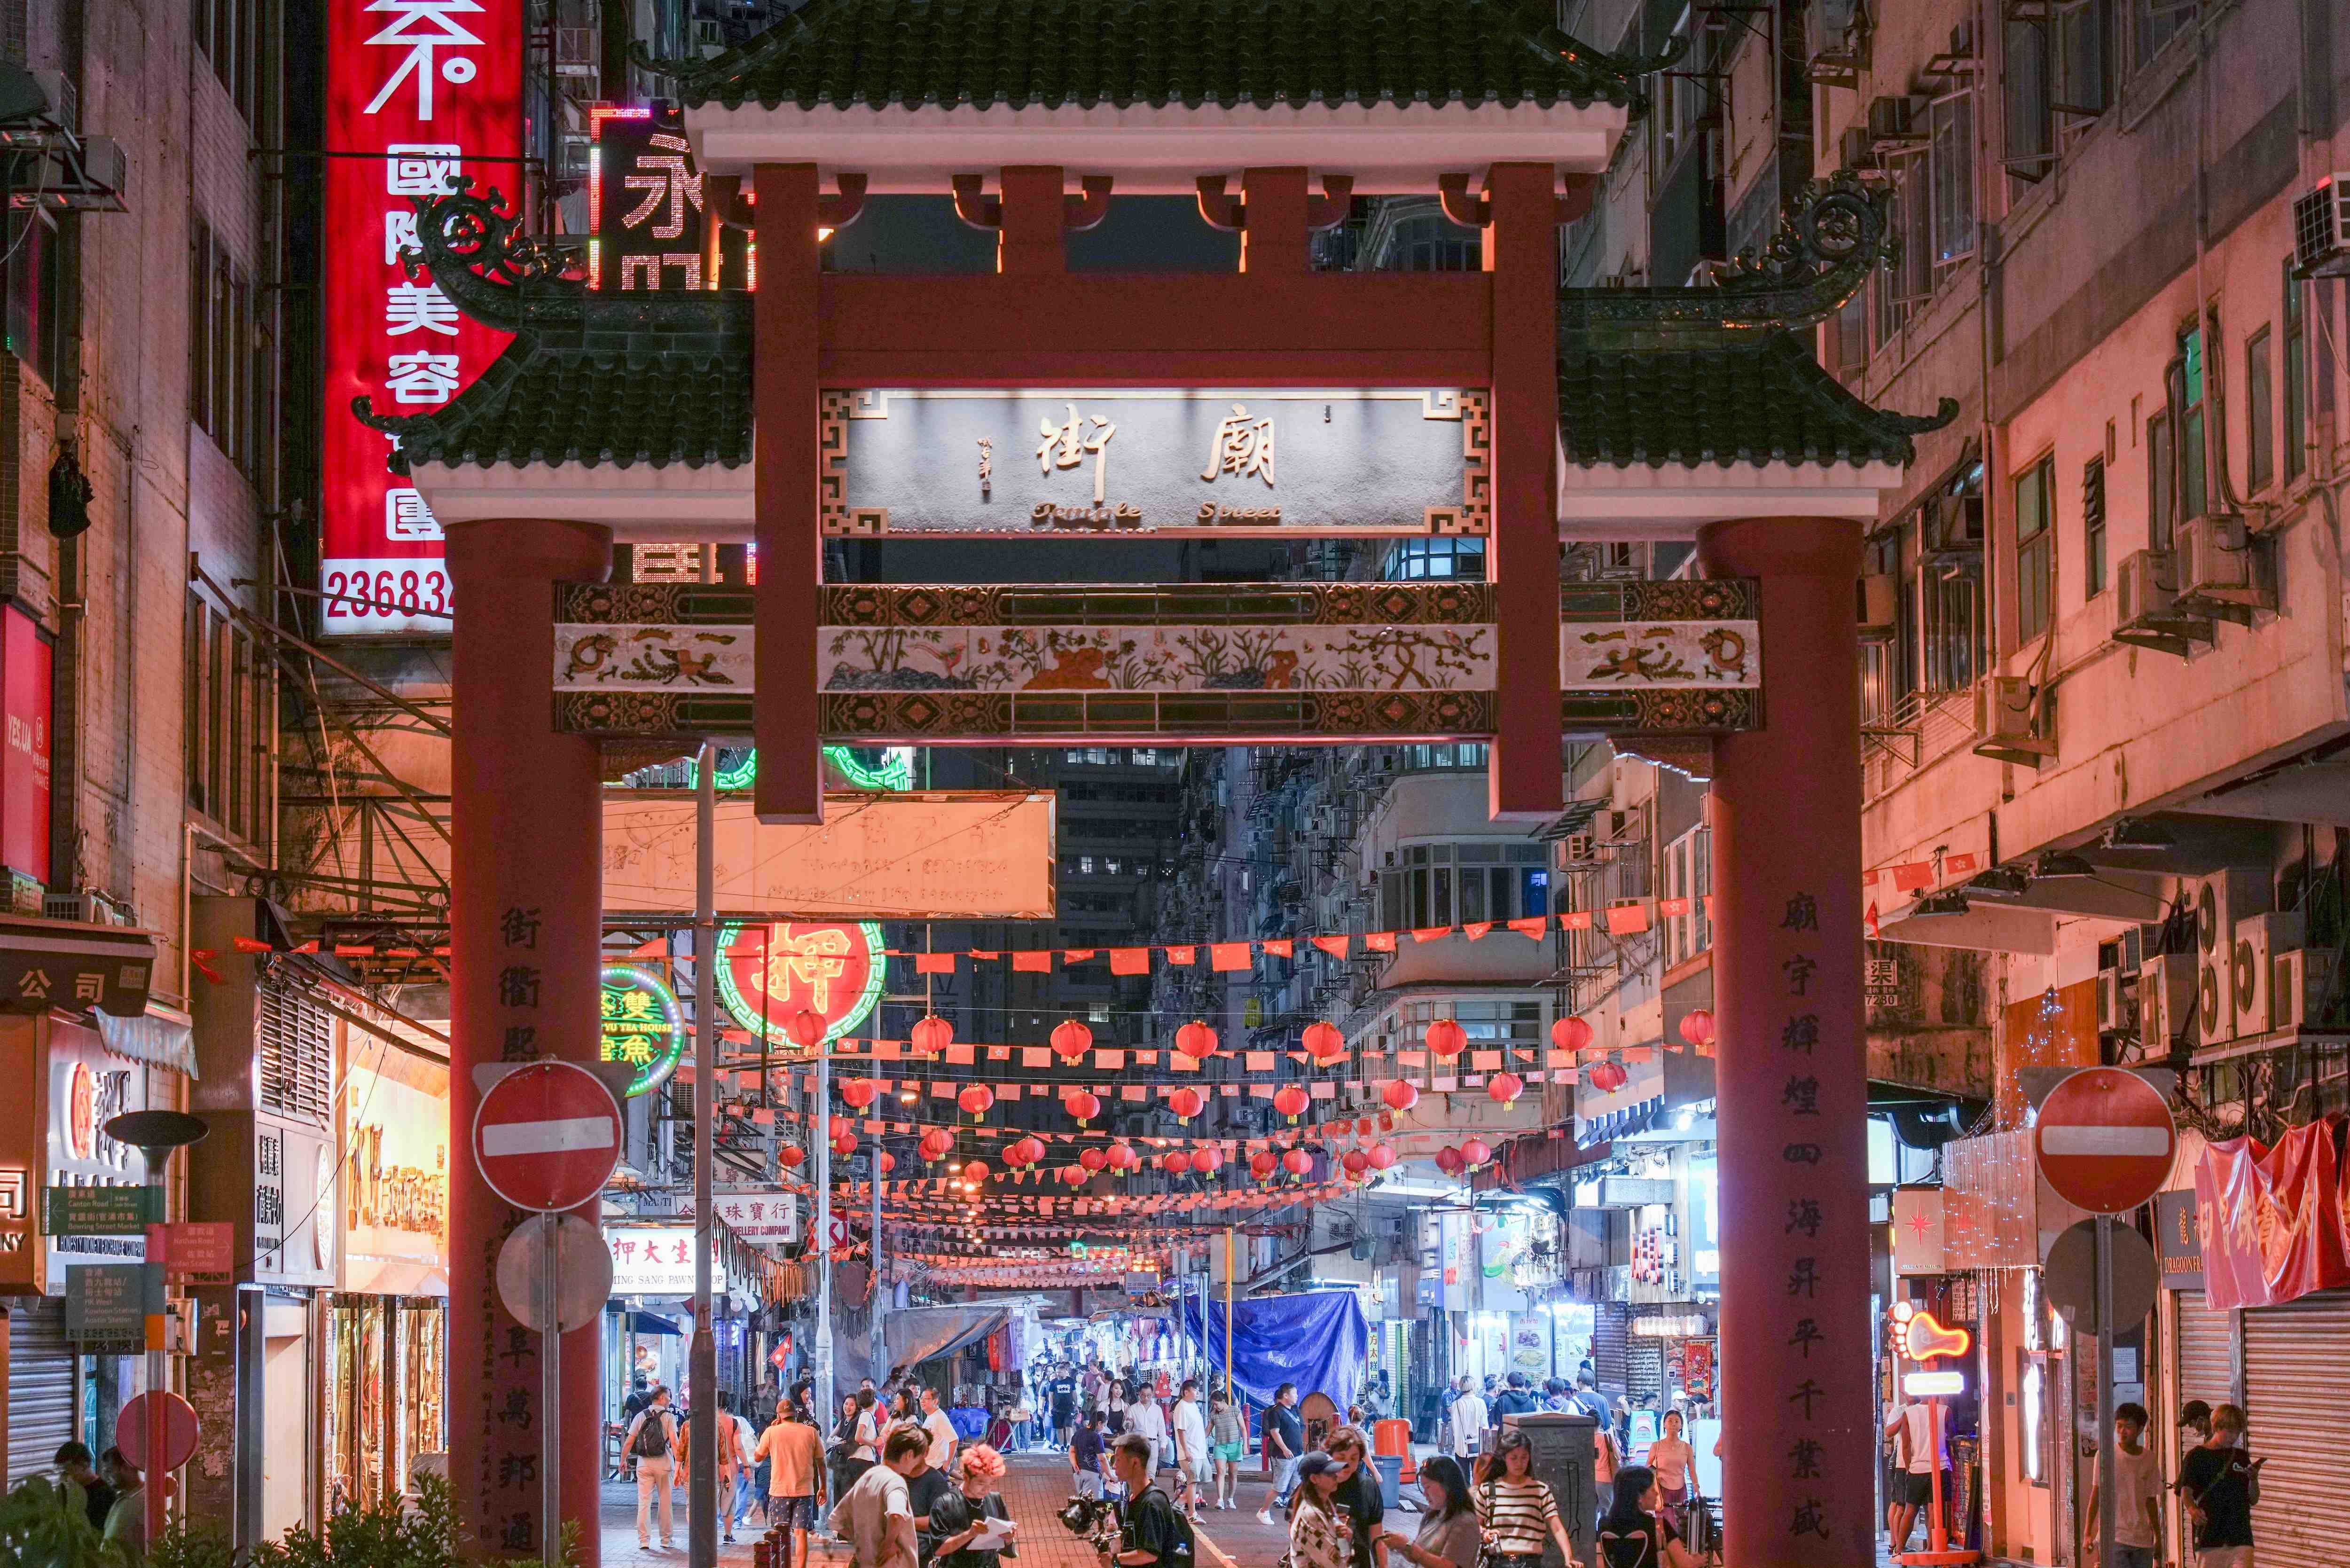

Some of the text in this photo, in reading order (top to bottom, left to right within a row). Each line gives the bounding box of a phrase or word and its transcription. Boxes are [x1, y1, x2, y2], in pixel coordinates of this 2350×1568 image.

[385, 144, 461, 541] 國美容團
[1031, 500, 1282, 522] Temple Street
[327, 570, 454, 618] 23683
[751, 922, 852, 1014] 押
[18, 968, 105, 1003] 公司
[619, 1023, 638, 1032] TEA
[639, 1023, 673, 1032] HOUSE
[678, 1202, 790, 1221] 金珠寶行
[68, 1223, 94, 1231] Bowring
[729, 1226, 790, 1236] WELLERY COMPANY
[60, 1234, 145, 1258] HONESTY MONEY EXCHANGE COMPAN
[2164, 1255, 2193, 1274] DRAGOON
[638, 1275, 664, 1285] SANG
[668, 1275, 694, 1285] PAWN
